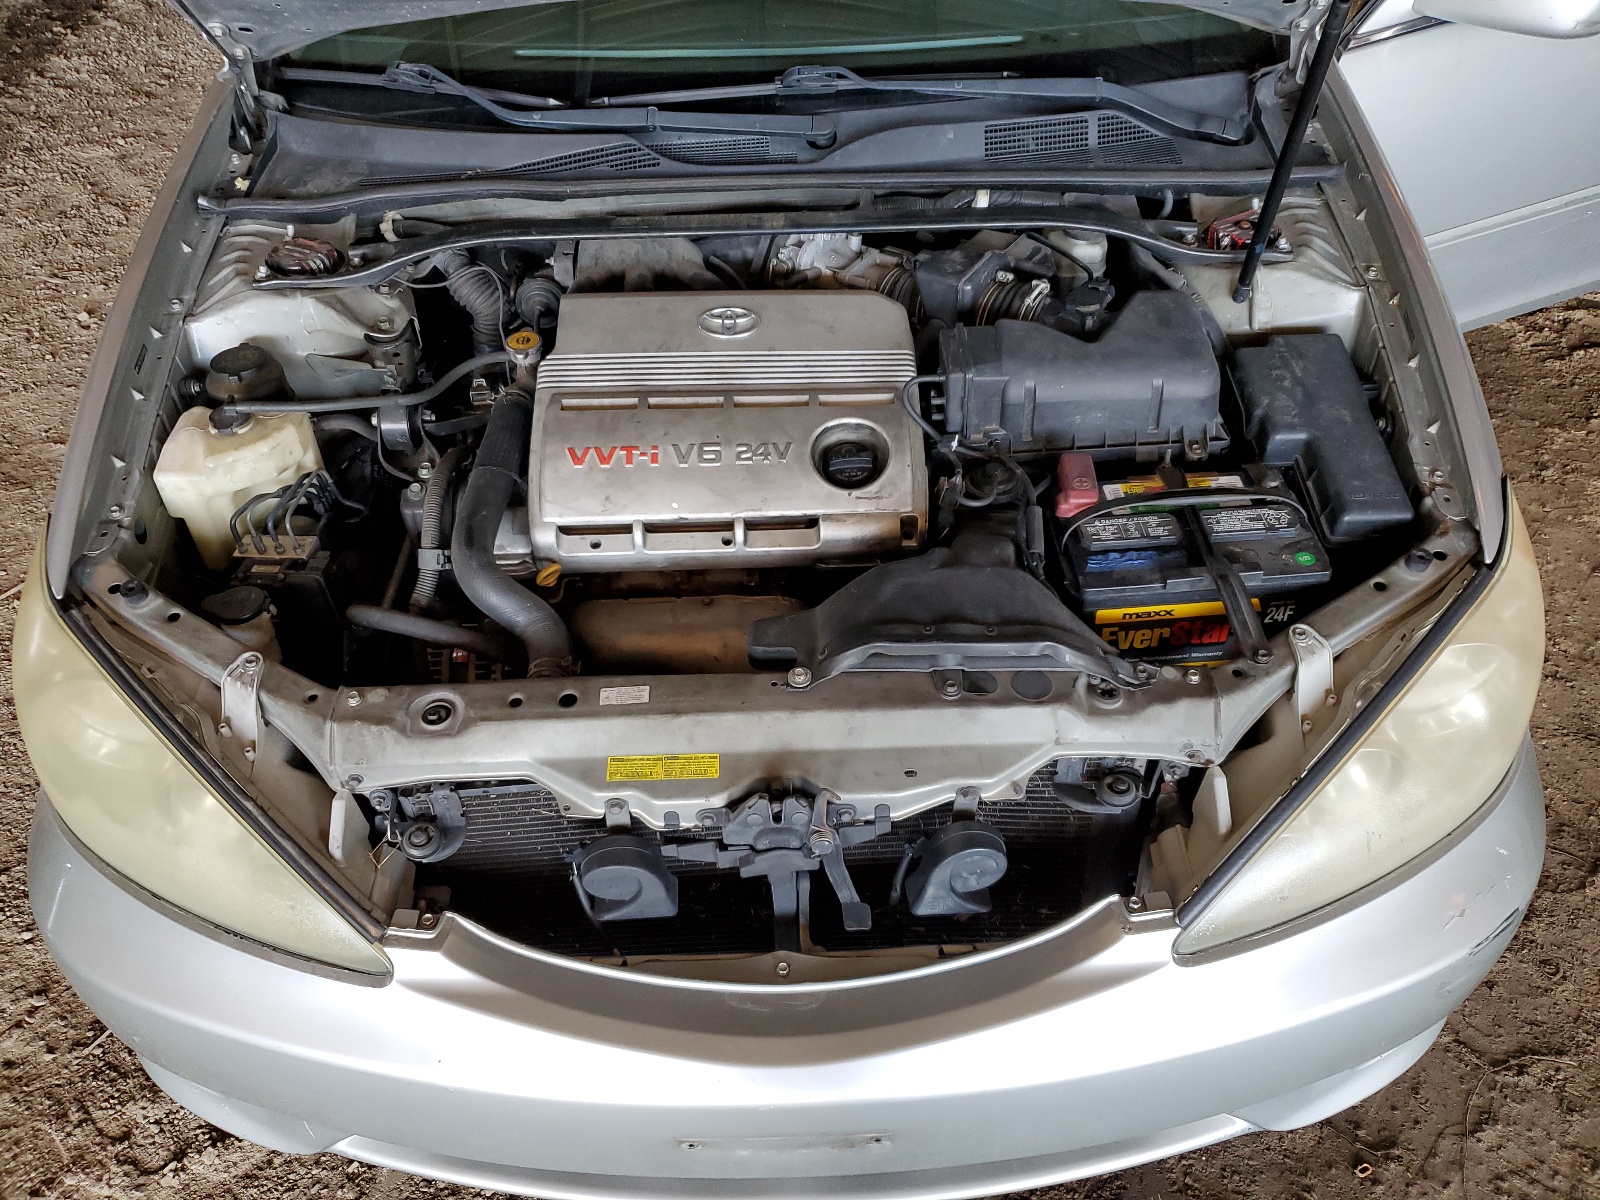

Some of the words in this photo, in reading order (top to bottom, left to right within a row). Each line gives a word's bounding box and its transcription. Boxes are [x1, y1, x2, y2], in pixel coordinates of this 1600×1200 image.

[567, 445, 659, 469] VVT-i
[671, 443, 722, 468] V6
[735, 442, 793, 465] 24V
[1121, 608, 1176, 620] maxx
[1263, 605, 1296, 624] 24F
